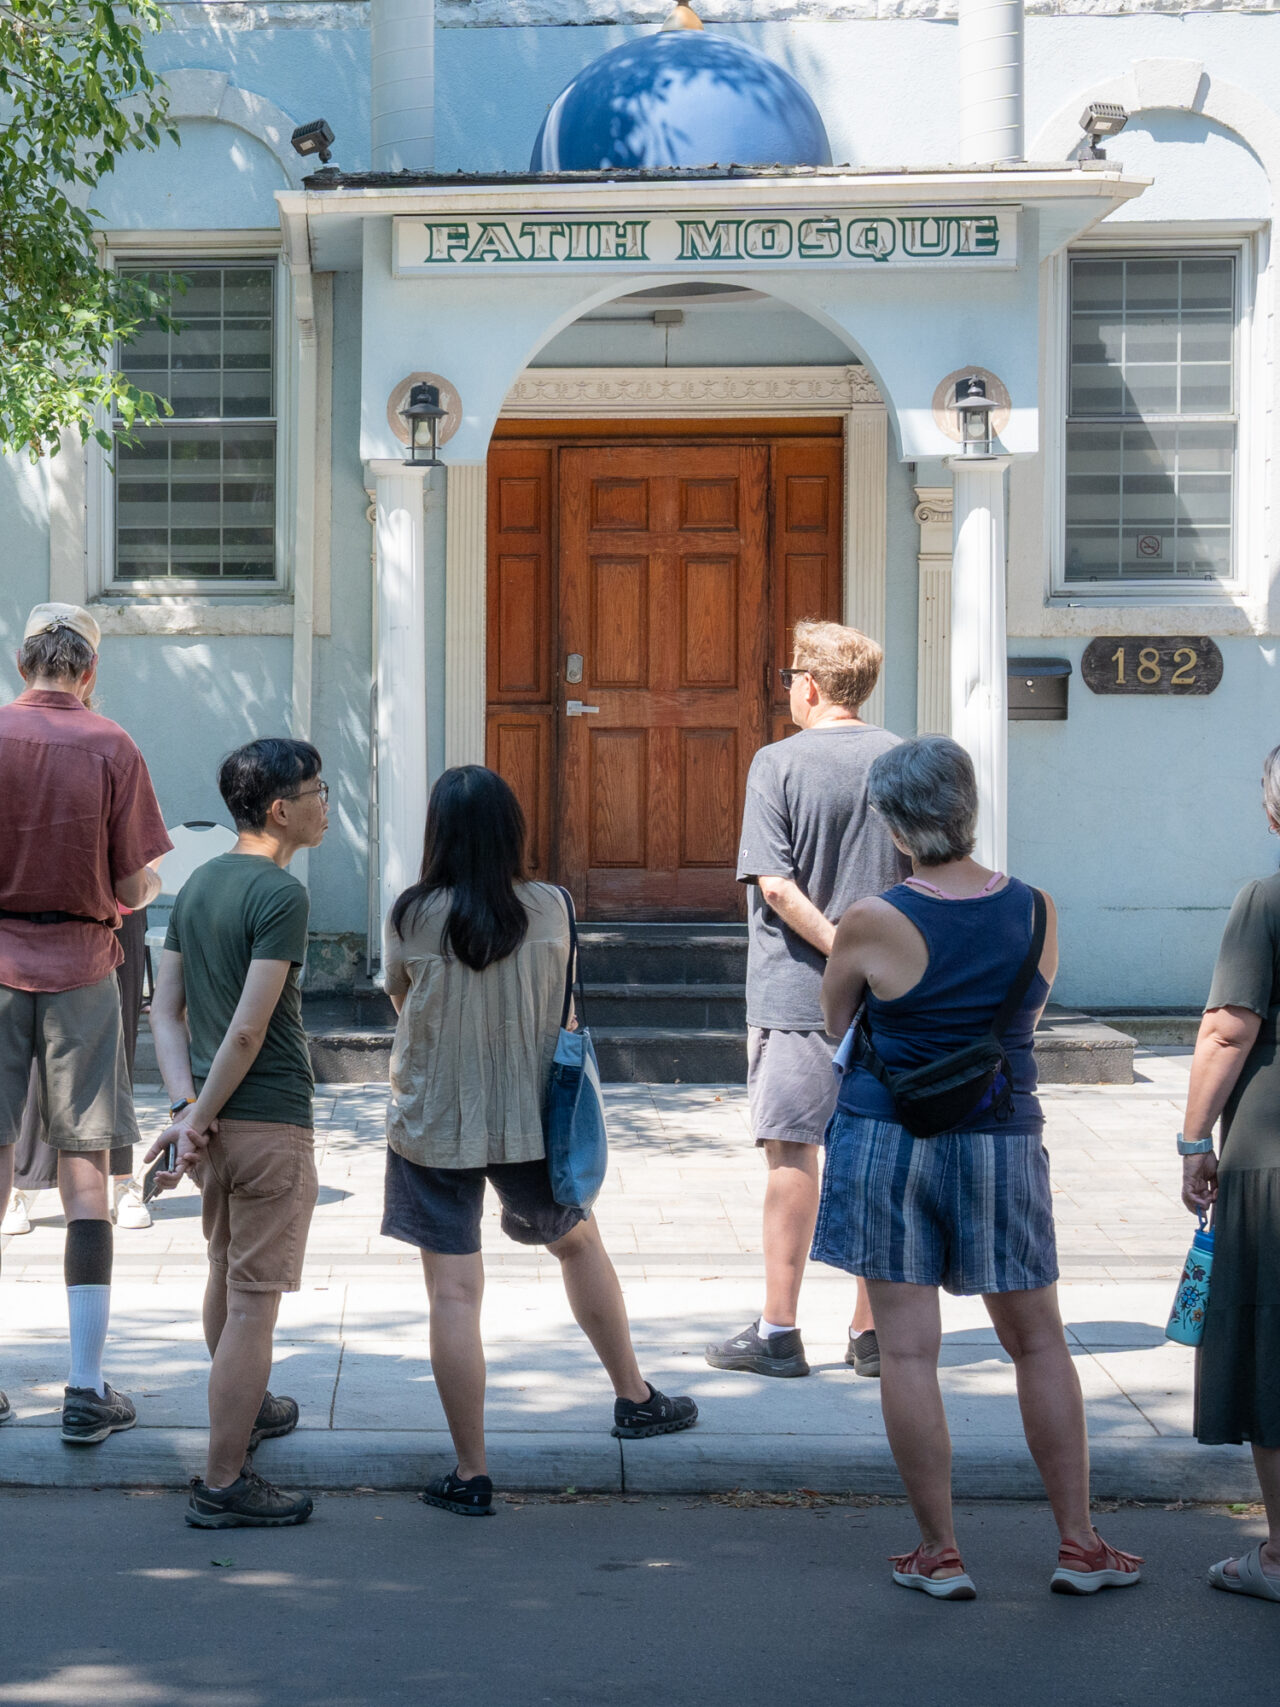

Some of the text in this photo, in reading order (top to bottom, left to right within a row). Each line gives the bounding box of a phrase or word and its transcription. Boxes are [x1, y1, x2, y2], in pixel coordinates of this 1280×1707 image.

[424, 215, 999, 263] FATIH MOSQUE
[1111, 647, 1198, 685] 182
